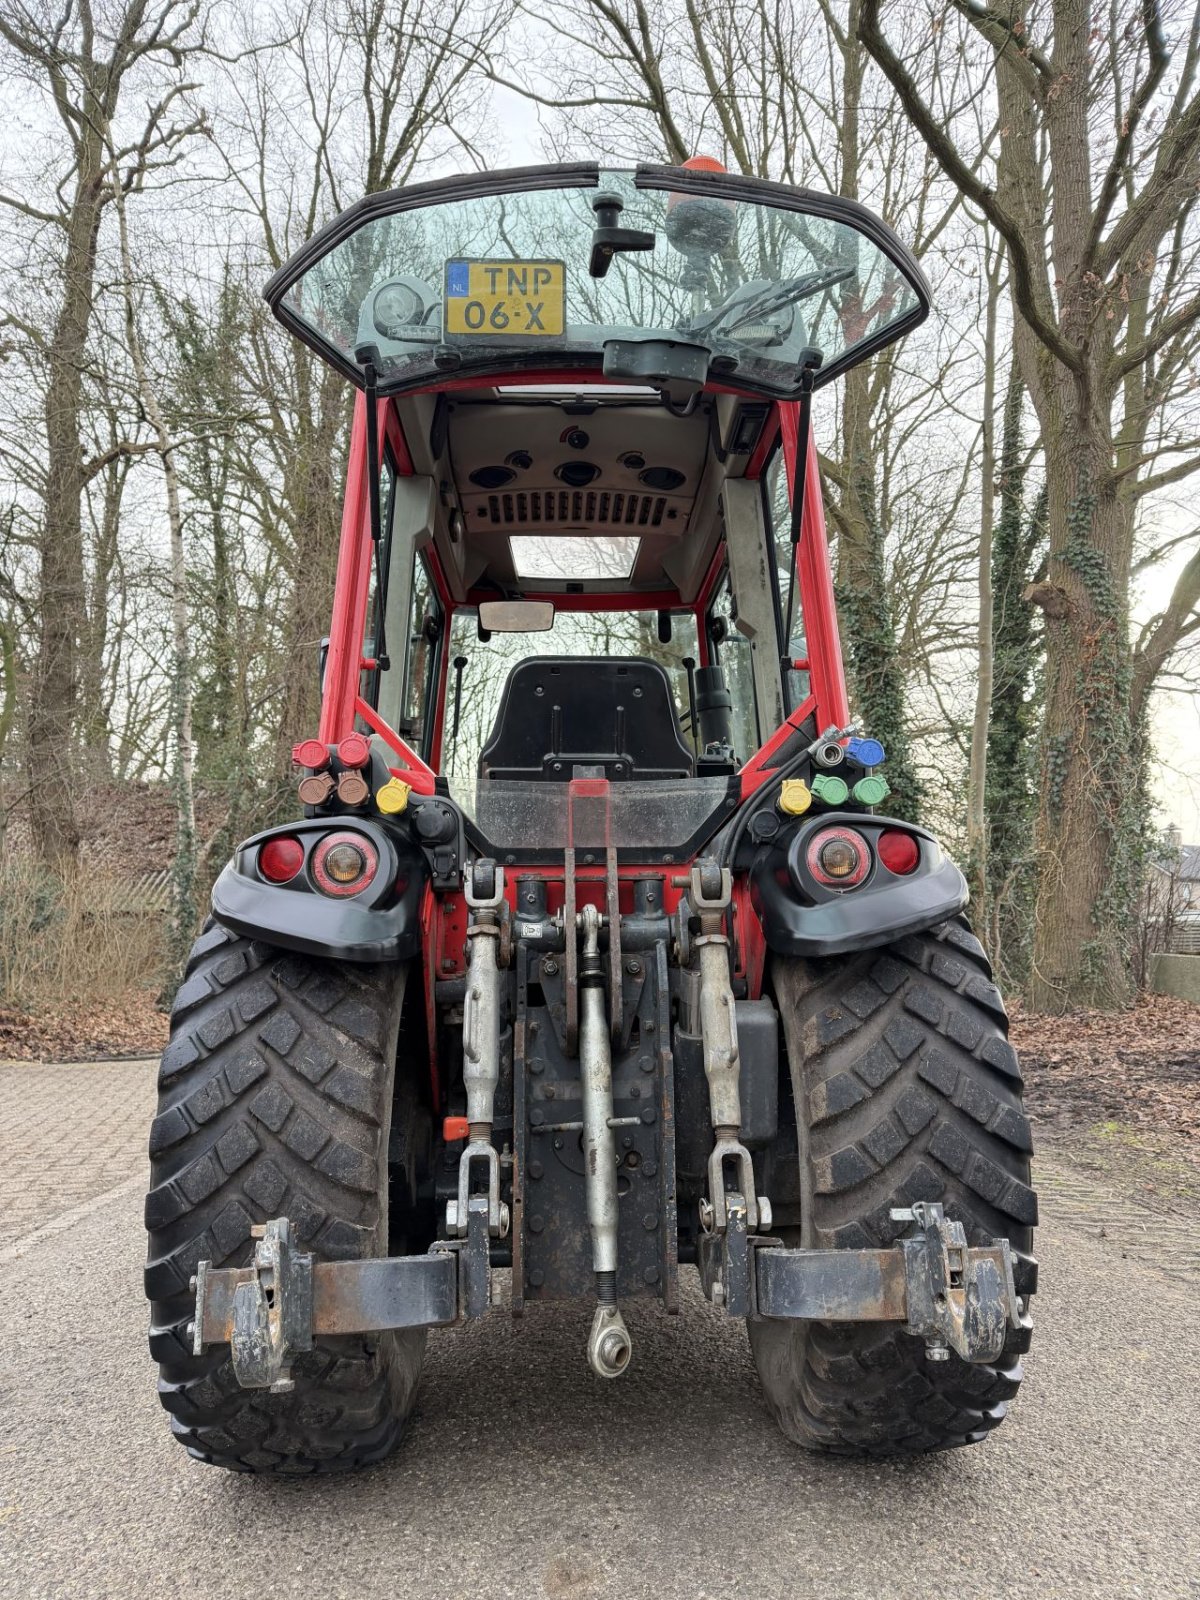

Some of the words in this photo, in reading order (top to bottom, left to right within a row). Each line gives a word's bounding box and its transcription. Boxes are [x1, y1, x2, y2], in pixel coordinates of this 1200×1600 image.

[452, 283, 465, 292] NL
[484, 267, 552, 296] TNP
[464, 300, 545, 330] 06-X
